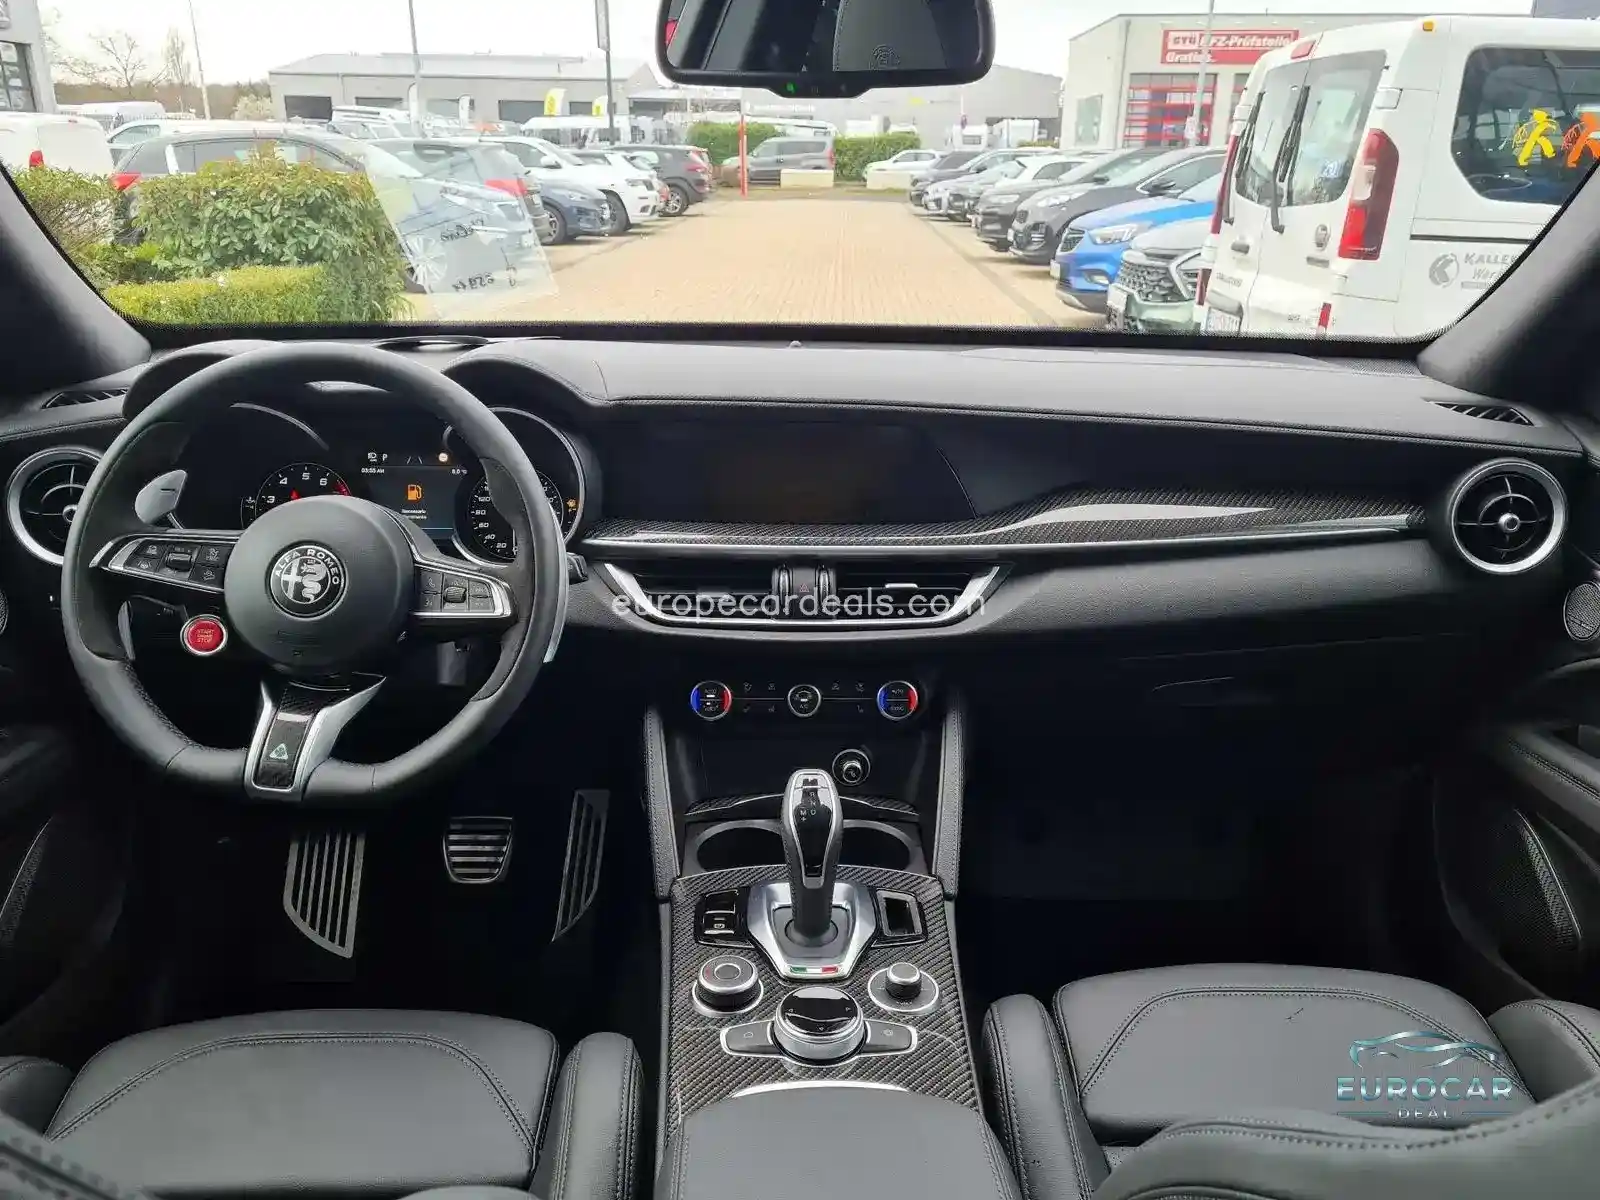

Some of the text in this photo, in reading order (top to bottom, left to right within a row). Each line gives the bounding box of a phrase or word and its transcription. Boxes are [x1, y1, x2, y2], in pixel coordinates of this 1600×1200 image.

[301, 472, 310, 480] 5
[279, 477, 288, 485] 4
[319, 478, 328, 486] 6
[266, 495, 275, 504] 3
[275, 548, 341, 585] ALFA ROMEO
